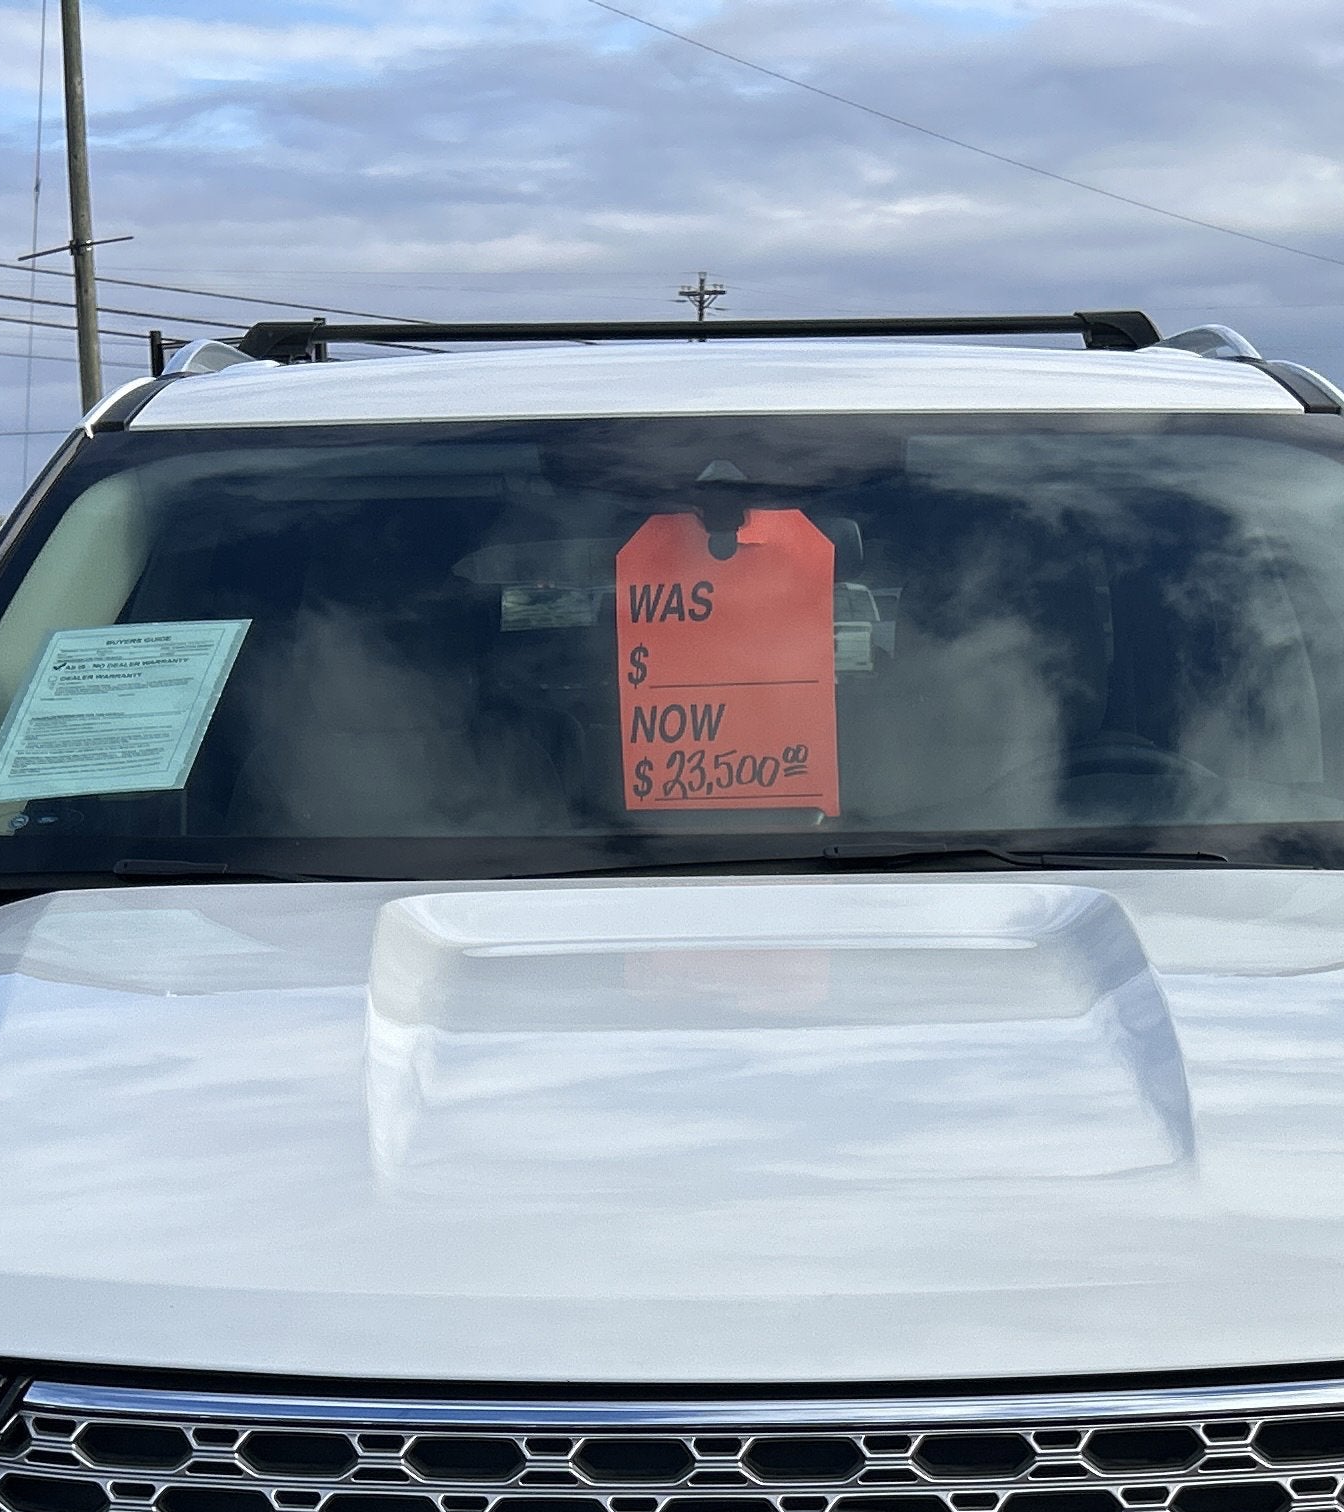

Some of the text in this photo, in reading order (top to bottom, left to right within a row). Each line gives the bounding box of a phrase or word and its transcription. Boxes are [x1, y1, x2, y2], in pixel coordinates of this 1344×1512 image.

[629, 580, 715, 623] WAS
[106, 635, 172, 646] BUYERS GUIDE
[107, 661, 141, 669] DEALER
[142, 657, 190, 666] WARRANTY
[627, 643, 649, 689] $
[59, 672, 143, 682] DEALER WARRANTY
[630, 703, 726, 743] NOW
